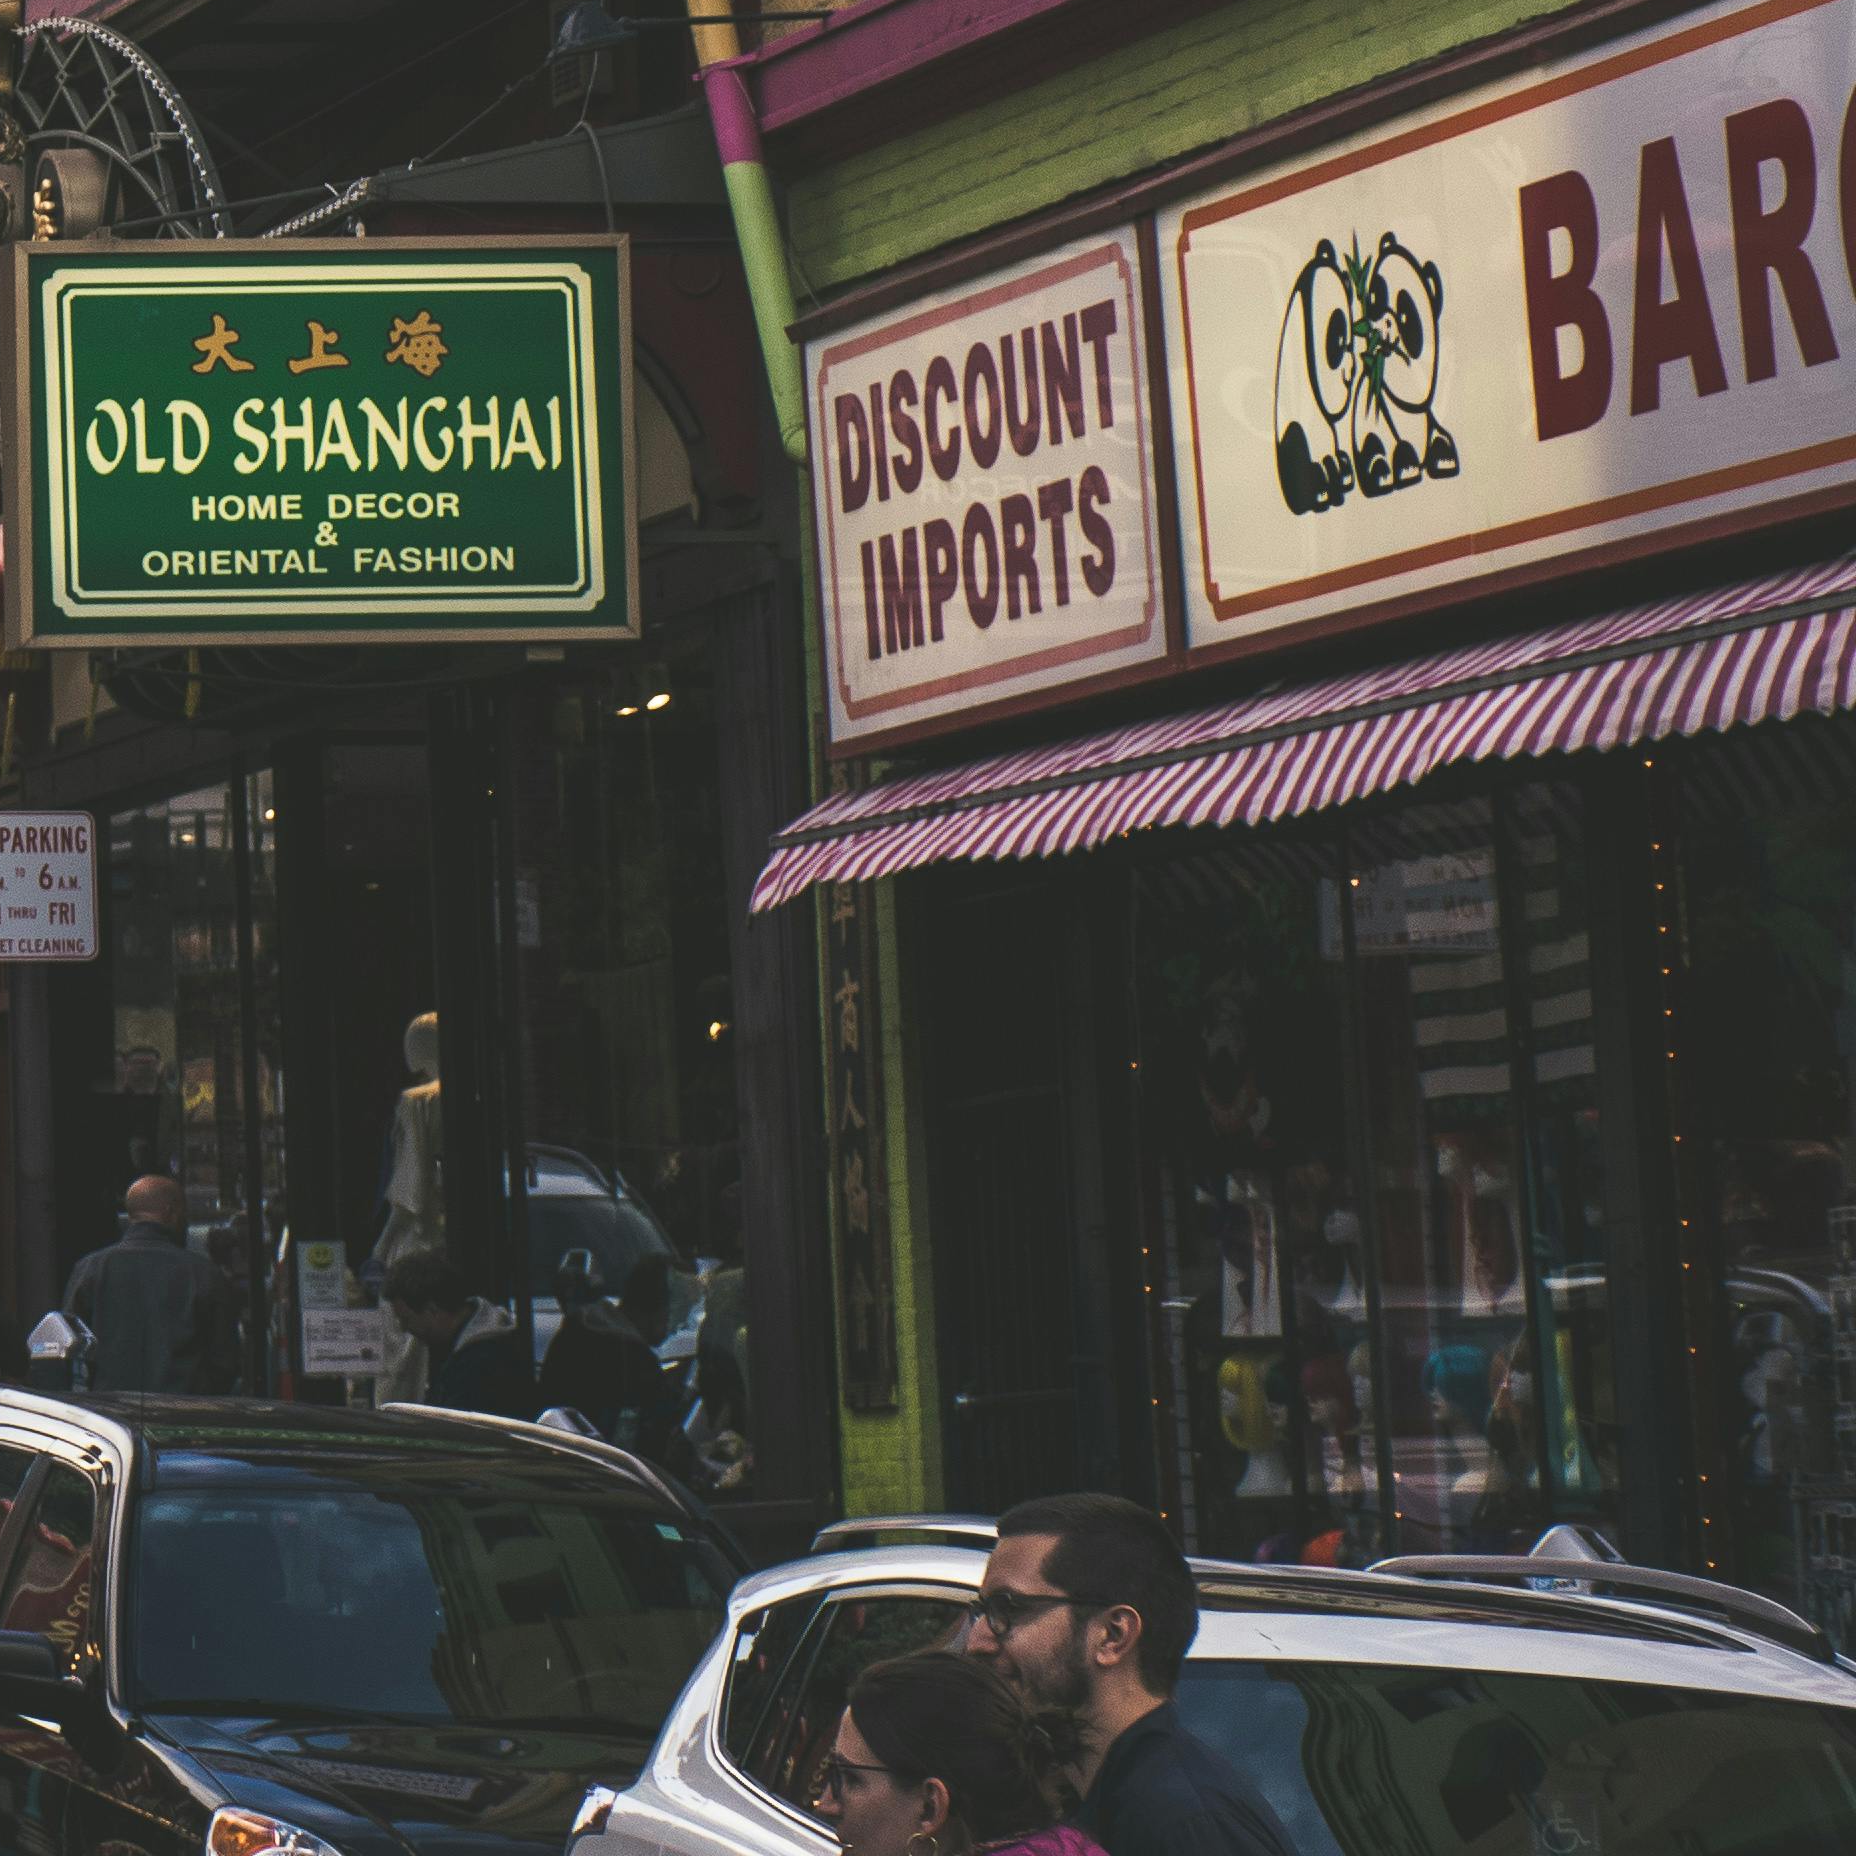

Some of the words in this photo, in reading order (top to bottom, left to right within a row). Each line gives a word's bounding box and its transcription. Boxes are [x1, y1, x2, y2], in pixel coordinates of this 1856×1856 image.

[1518, 79, 1856, 443] BAR
[191, 308, 452, 378] 大上海
[833, 300, 1119, 514] DISCOUNT
[86, 396, 211, 476] OLD
[232, 394, 564, 475] SHANGHAI
[191, 493, 302, 522] HOME
[327, 492, 460, 521] DECOR
[314, 522, 338, 547] &
[142, 548, 328, 577] ORIENTAL
[352, 545, 515, 574] FASHION
[860, 464, 1118, 661] IMPORTS
[8, 906, 37, 920] THRU
[48, 902, 76, 925] FRI
[18, 937, 85, 954] CLEANING
